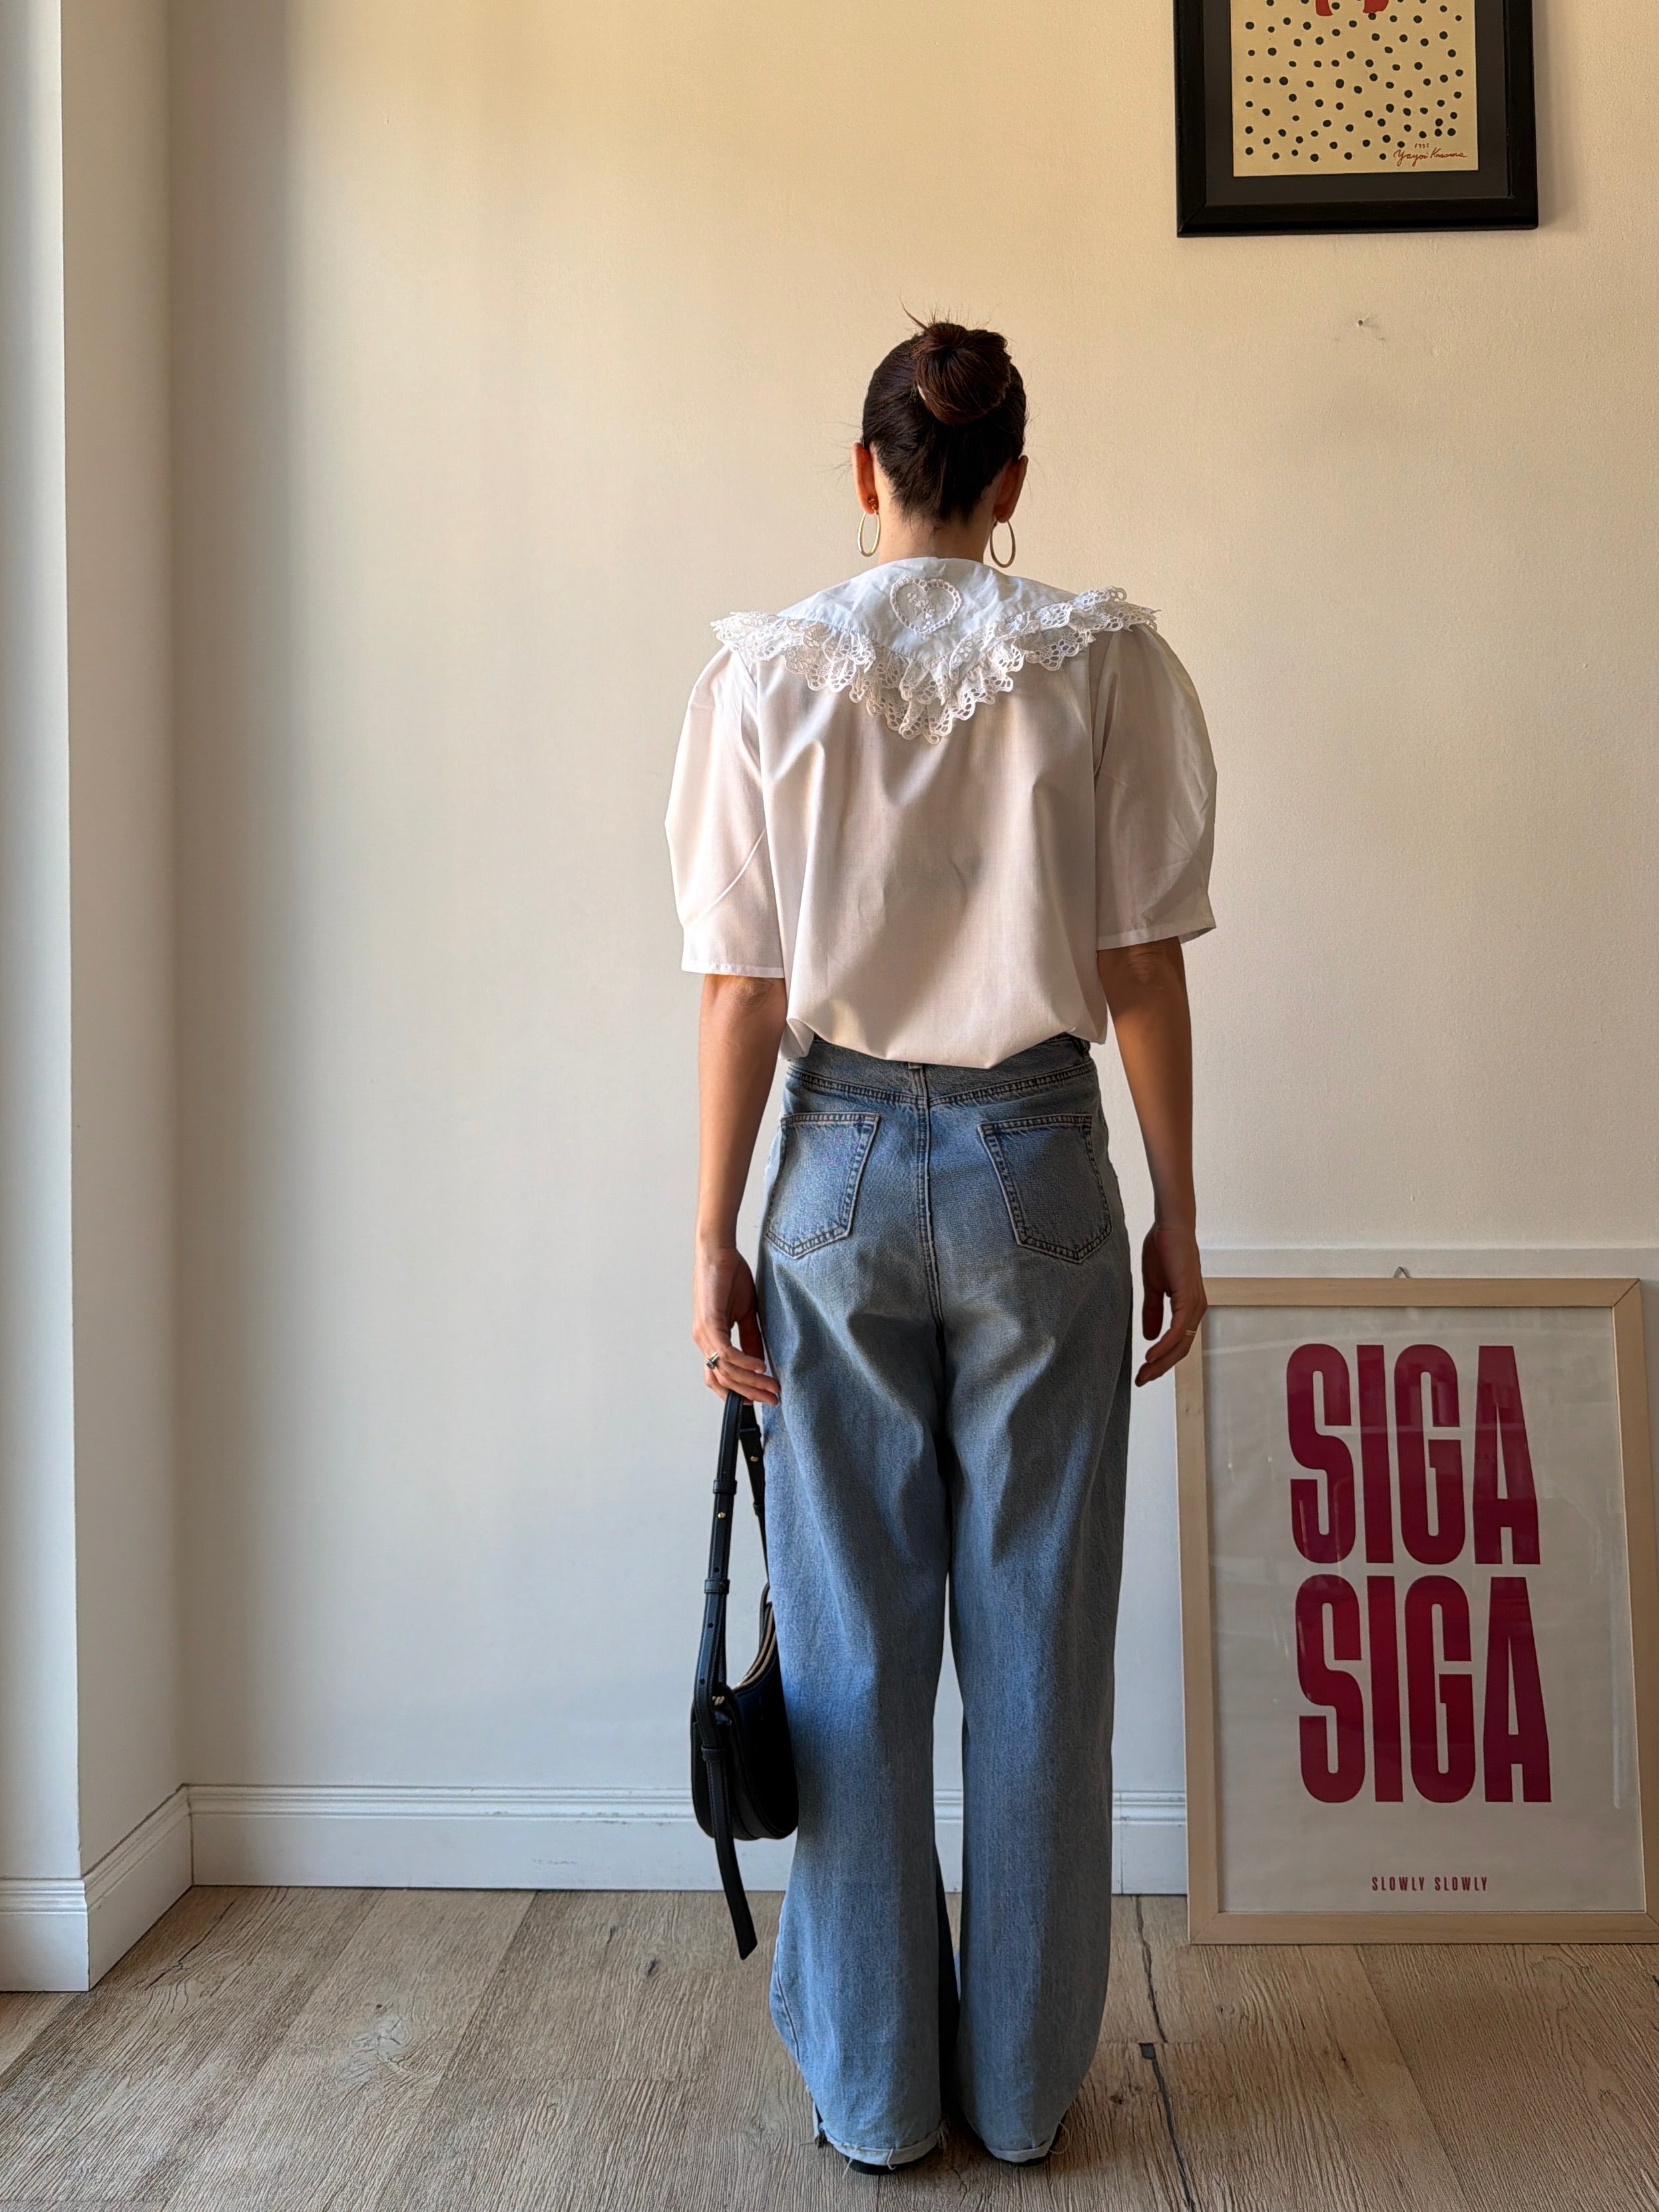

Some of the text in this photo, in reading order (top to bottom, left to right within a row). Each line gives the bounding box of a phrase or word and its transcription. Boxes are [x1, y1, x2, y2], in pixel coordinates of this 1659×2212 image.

[1286, 1344, 1540, 1564] SIGA
[1296, 1575, 1551, 1803] SIGA
[1371, 1876, 1487, 1891] SLOWLY SLOWLY
